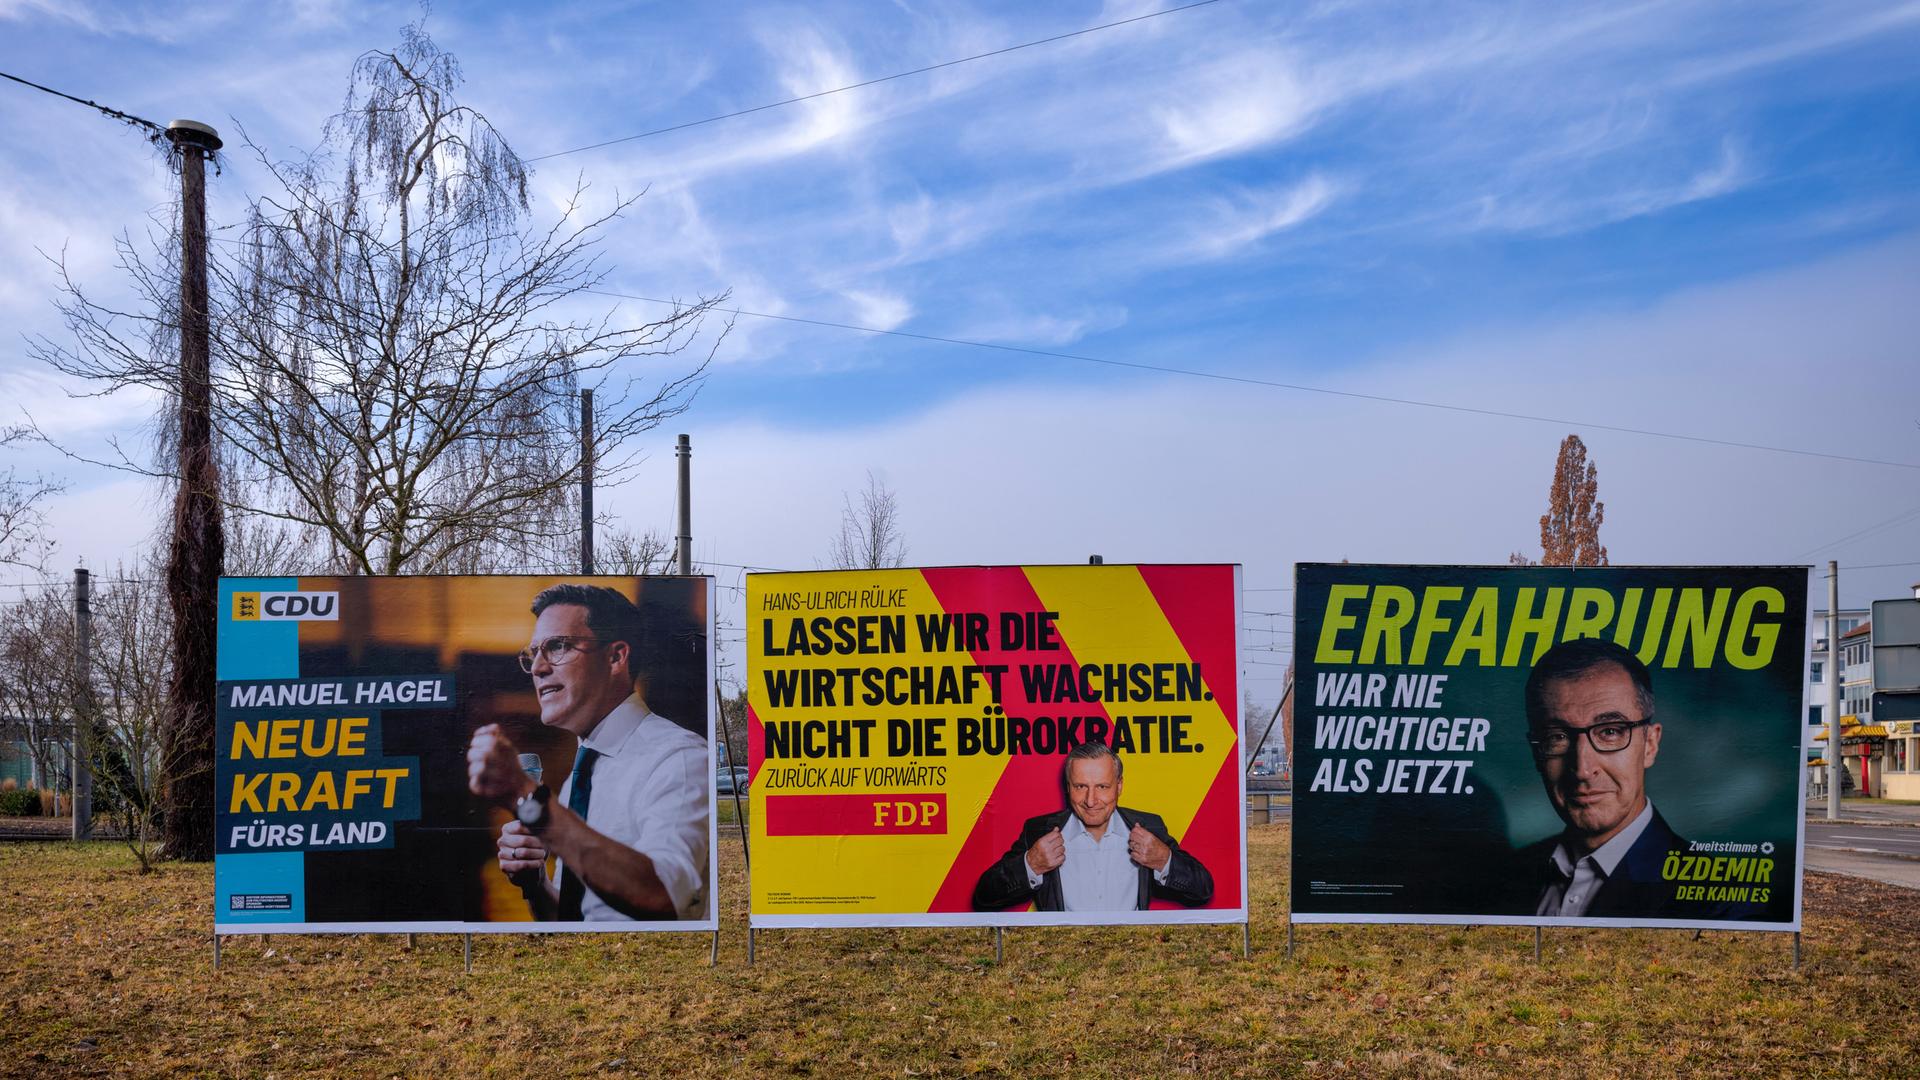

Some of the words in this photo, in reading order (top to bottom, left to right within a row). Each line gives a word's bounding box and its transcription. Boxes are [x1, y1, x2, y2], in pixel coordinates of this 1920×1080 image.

[264, 596, 334, 616] CDU
[762, 590, 857, 611] HANS-ULRICH
[860, 586, 908, 608] RÜLKE
[763, 615, 906, 656] LASSEN
[916, 613, 989, 653] WIR
[1000, 611, 1060, 651] DIE
[1314, 584, 1786, 670] ERFAHRUNG
[230, 682, 349, 708] MANUEL
[355, 679, 448, 704] HAGEL
[763, 665, 1009, 708] WIRTSCHAFT
[1020, 662, 1214, 704] WACHSEN.
[1314, 672, 1387, 708] WAR
[1391, 674, 1448, 709] NIE
[230, 717, 369, 760] NEUE
[764, 719, 876, 760] NICHT
[888, 717, 947, 757] DIE
[957, 705, 1204, 756] BÜROKRATIE.
[1314, 716, 1490, 752] WICHTIGER
[229, 768, 409, 814] KRAFT
[765, 763, 829, 789] ZURÜCK
[831, 768, 861, 788] AUF
[864, 760, 947, 787] VORWÄRTS
[1310, 758, 1373, 794] ALS
[1375, 760, 1474, 795] JETZT.
[873, 802, 939, 827] FDP
[230, 819, 304, 848] FÜRS
[309, 821, 386, 845] LAND
[1689, 841, 1758, 852] Zweitstimme
[1662, 850, 1774, 882] ÖZDEMIR
[1676, 886, 1705, 900] DER
[1707, 886, 1749, 902] KANN
[1750, 888, 1771, 903] ES
